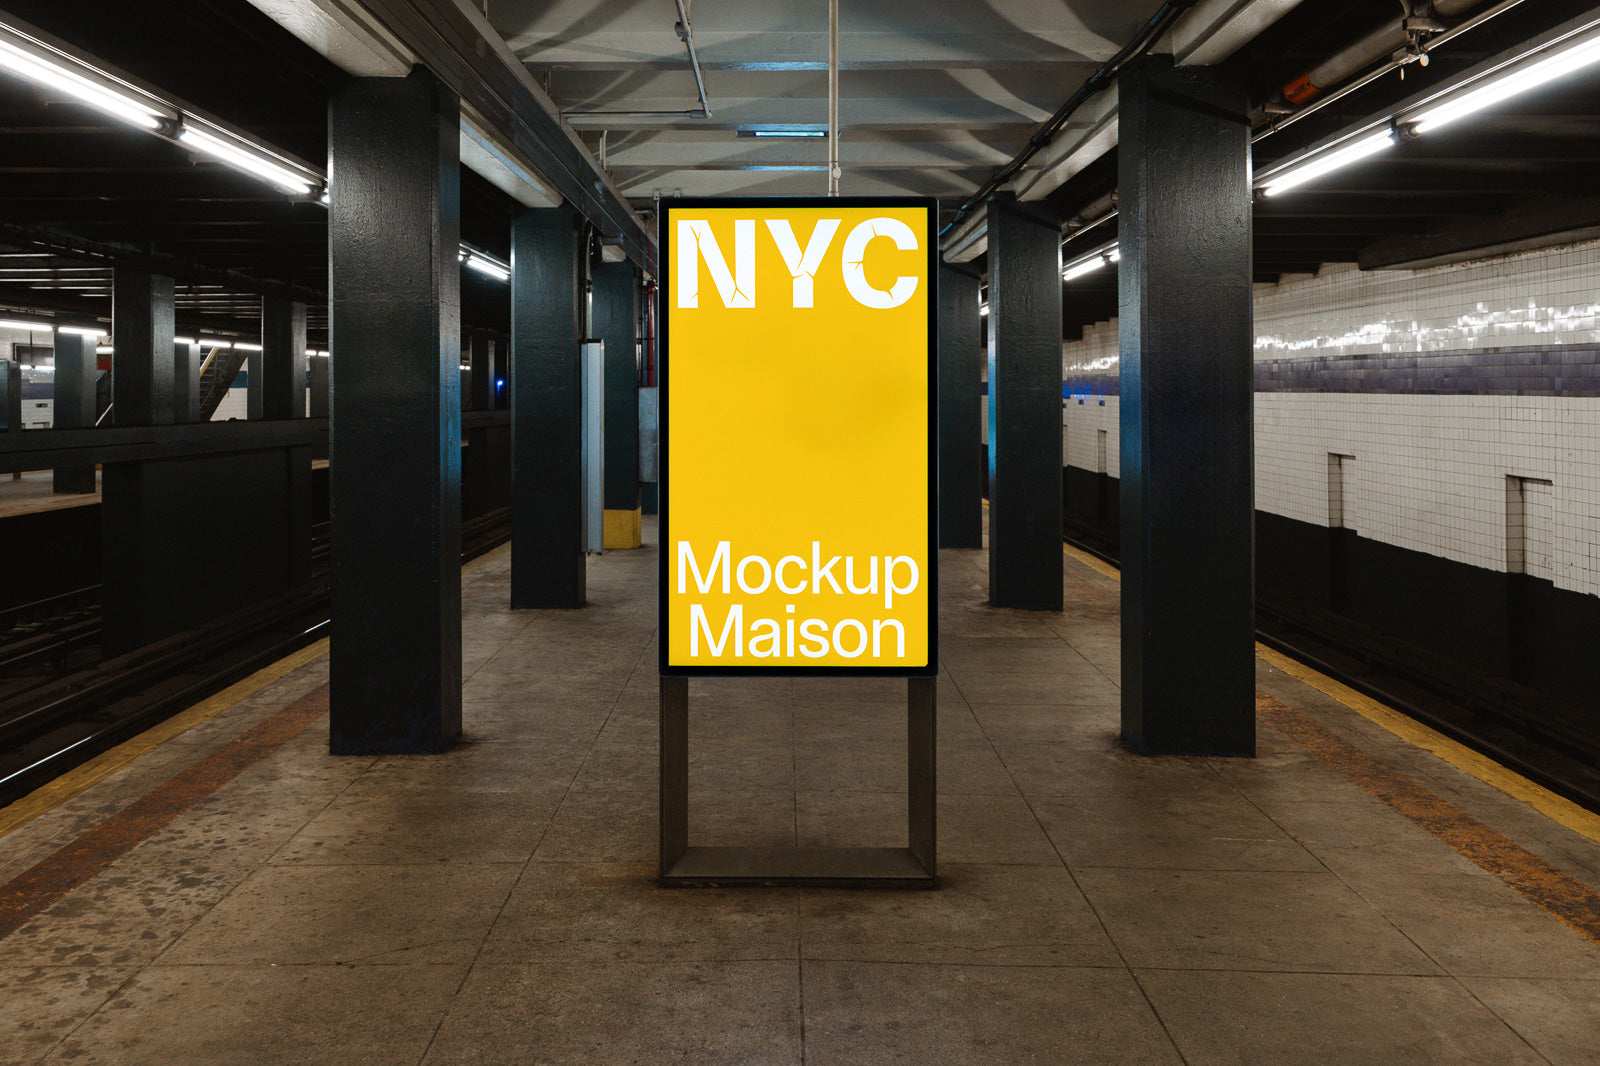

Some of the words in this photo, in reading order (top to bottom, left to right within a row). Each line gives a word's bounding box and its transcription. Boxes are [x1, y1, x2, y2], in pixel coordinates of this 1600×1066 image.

[677, 217, 919, 309] NYC
[677, 541, 920, 609] Mockup
[690, 604, 905, 658] Maison
